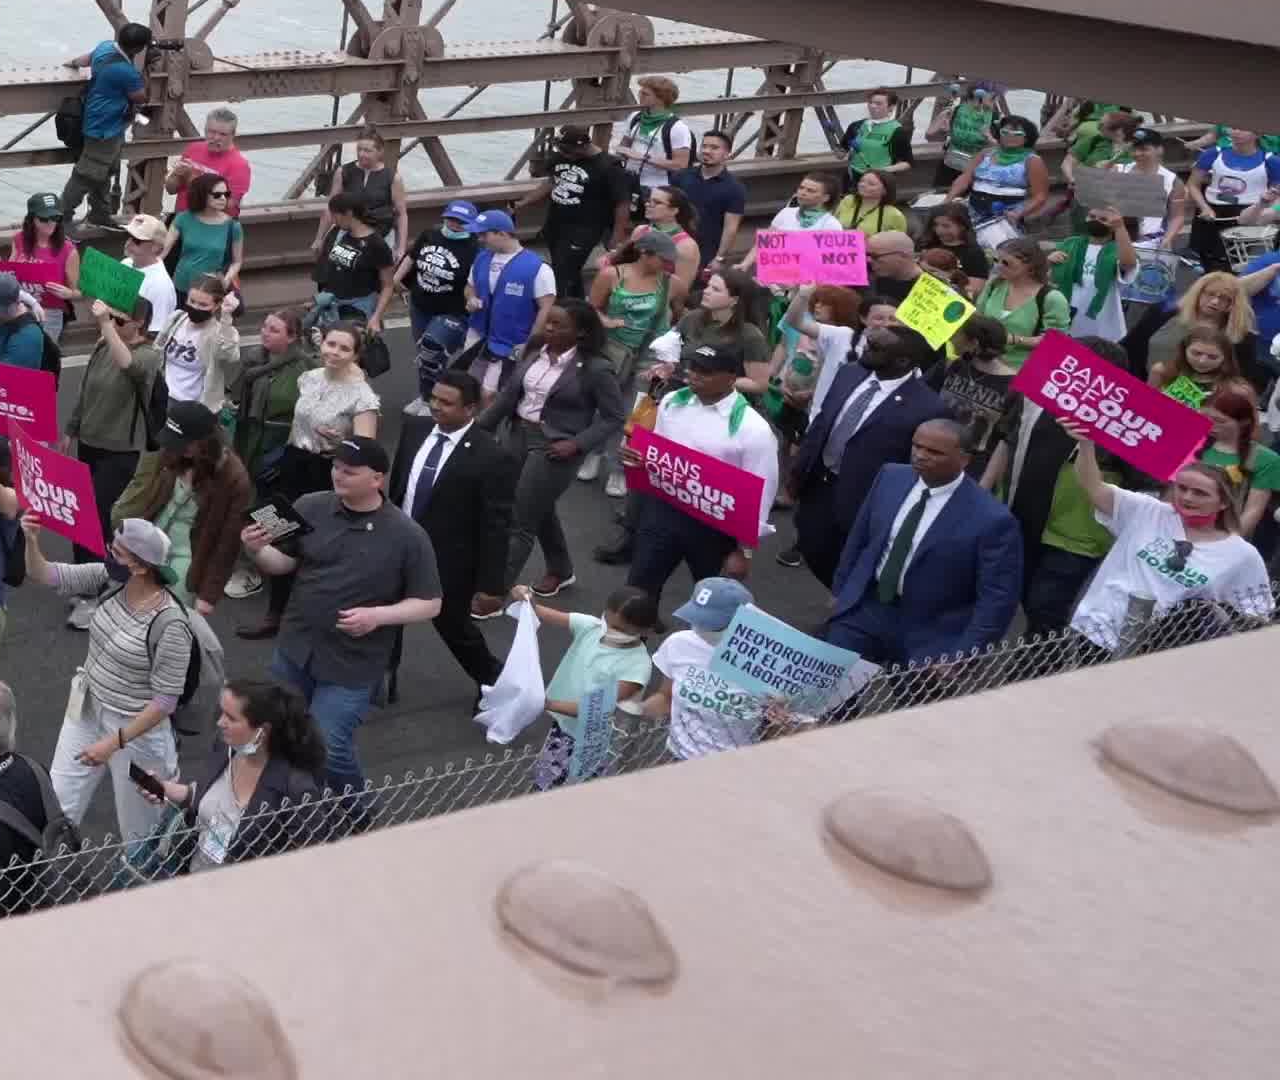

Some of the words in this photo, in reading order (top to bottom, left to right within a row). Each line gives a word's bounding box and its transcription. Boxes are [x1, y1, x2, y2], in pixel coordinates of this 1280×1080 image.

[758, 234, 787, 249] NOT
[813, 234, 858, 248] YOUR
[822, 253, 858, 265] NOT
[1060, 355, 1129, 404] BANS
[1041, 380, 1142, 446] BODIES
[1050, 369, 1101, 401] OFF
[1098, 399, 1164, 442] OUR
[646, 445, 702, 481] BANS
[35, 477, 80, 512] OUR
[645, 461, 683, 486] OFF
[686, 479, 736, 512] OUR
[648, 474, 726, 520] BODIES
[1137, 549, 1197, 588] BODIES
[728, 636, 759, 662] POR
[762, 658, 778, 676] EL
[734, 623, 846, 679] NEOYORQUINOS
[686, 666, 729, 690] BANS
[720, 650, 738, 668] AL
[742, 662, 801, 696] ABORTO
